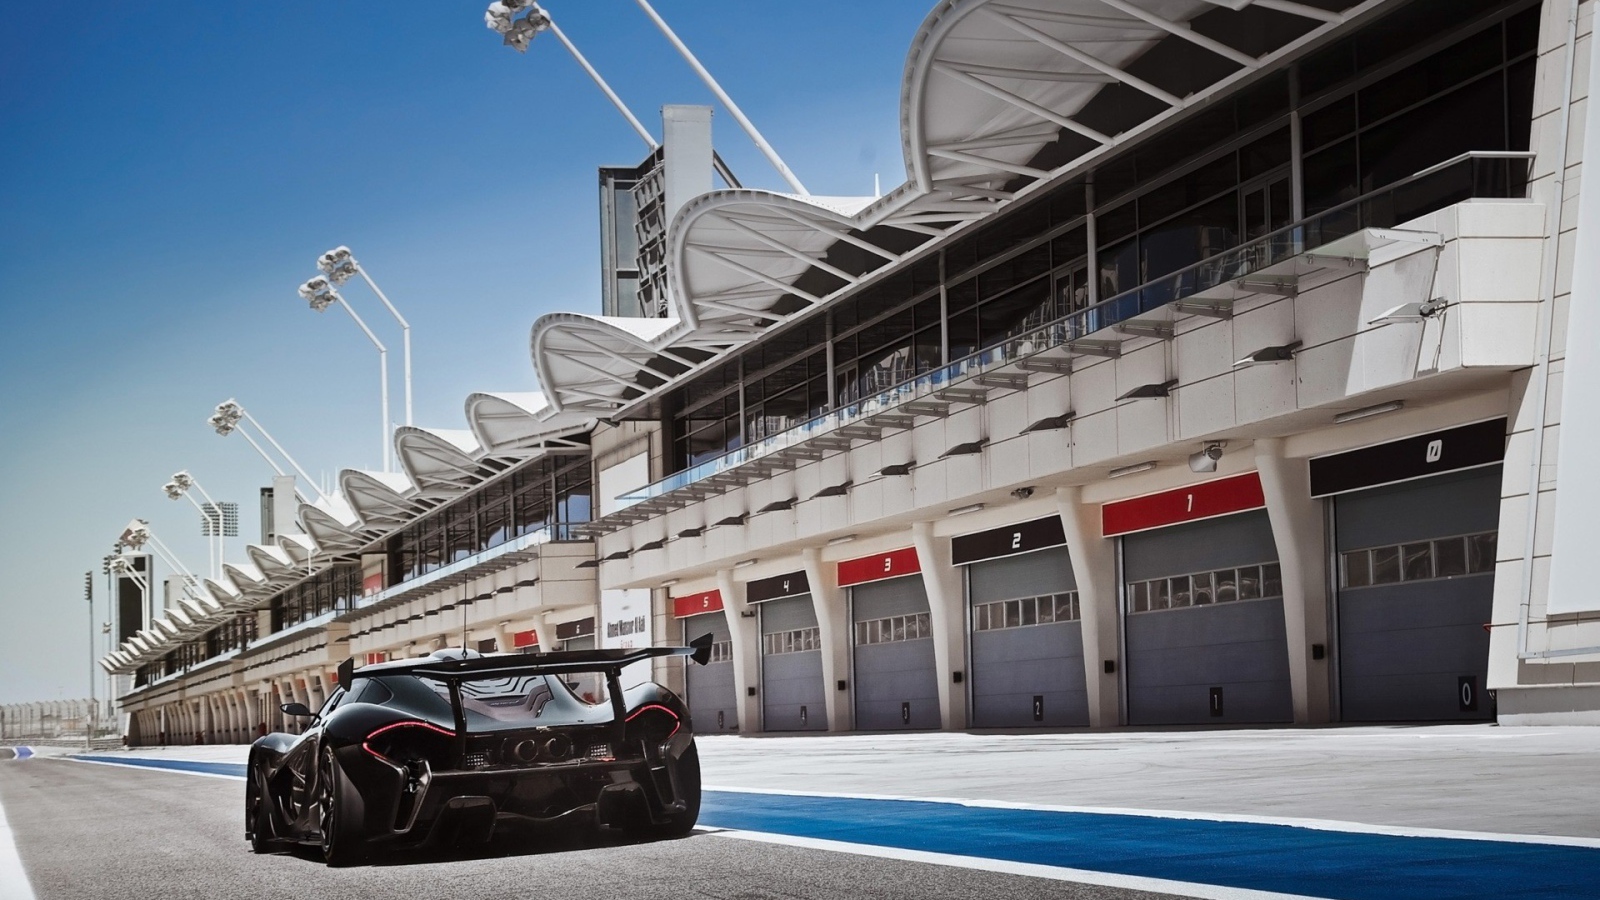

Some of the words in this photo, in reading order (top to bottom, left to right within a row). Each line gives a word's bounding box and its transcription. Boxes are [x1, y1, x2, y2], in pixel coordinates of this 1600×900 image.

[1426, 439, 1442, 463] 0
[1187, 494, 1193, 512] 1
[1012, 533, 1021, 548] 2
[884, 557, 891, 572] 3
[783, 580, 790, 592] 4
[703, 596, 709, 608] 5
[1214, 694, 1218, 709] 1
[1462, 682, 1471, 706] 0
[1035, 701, 1040, 716] 2
